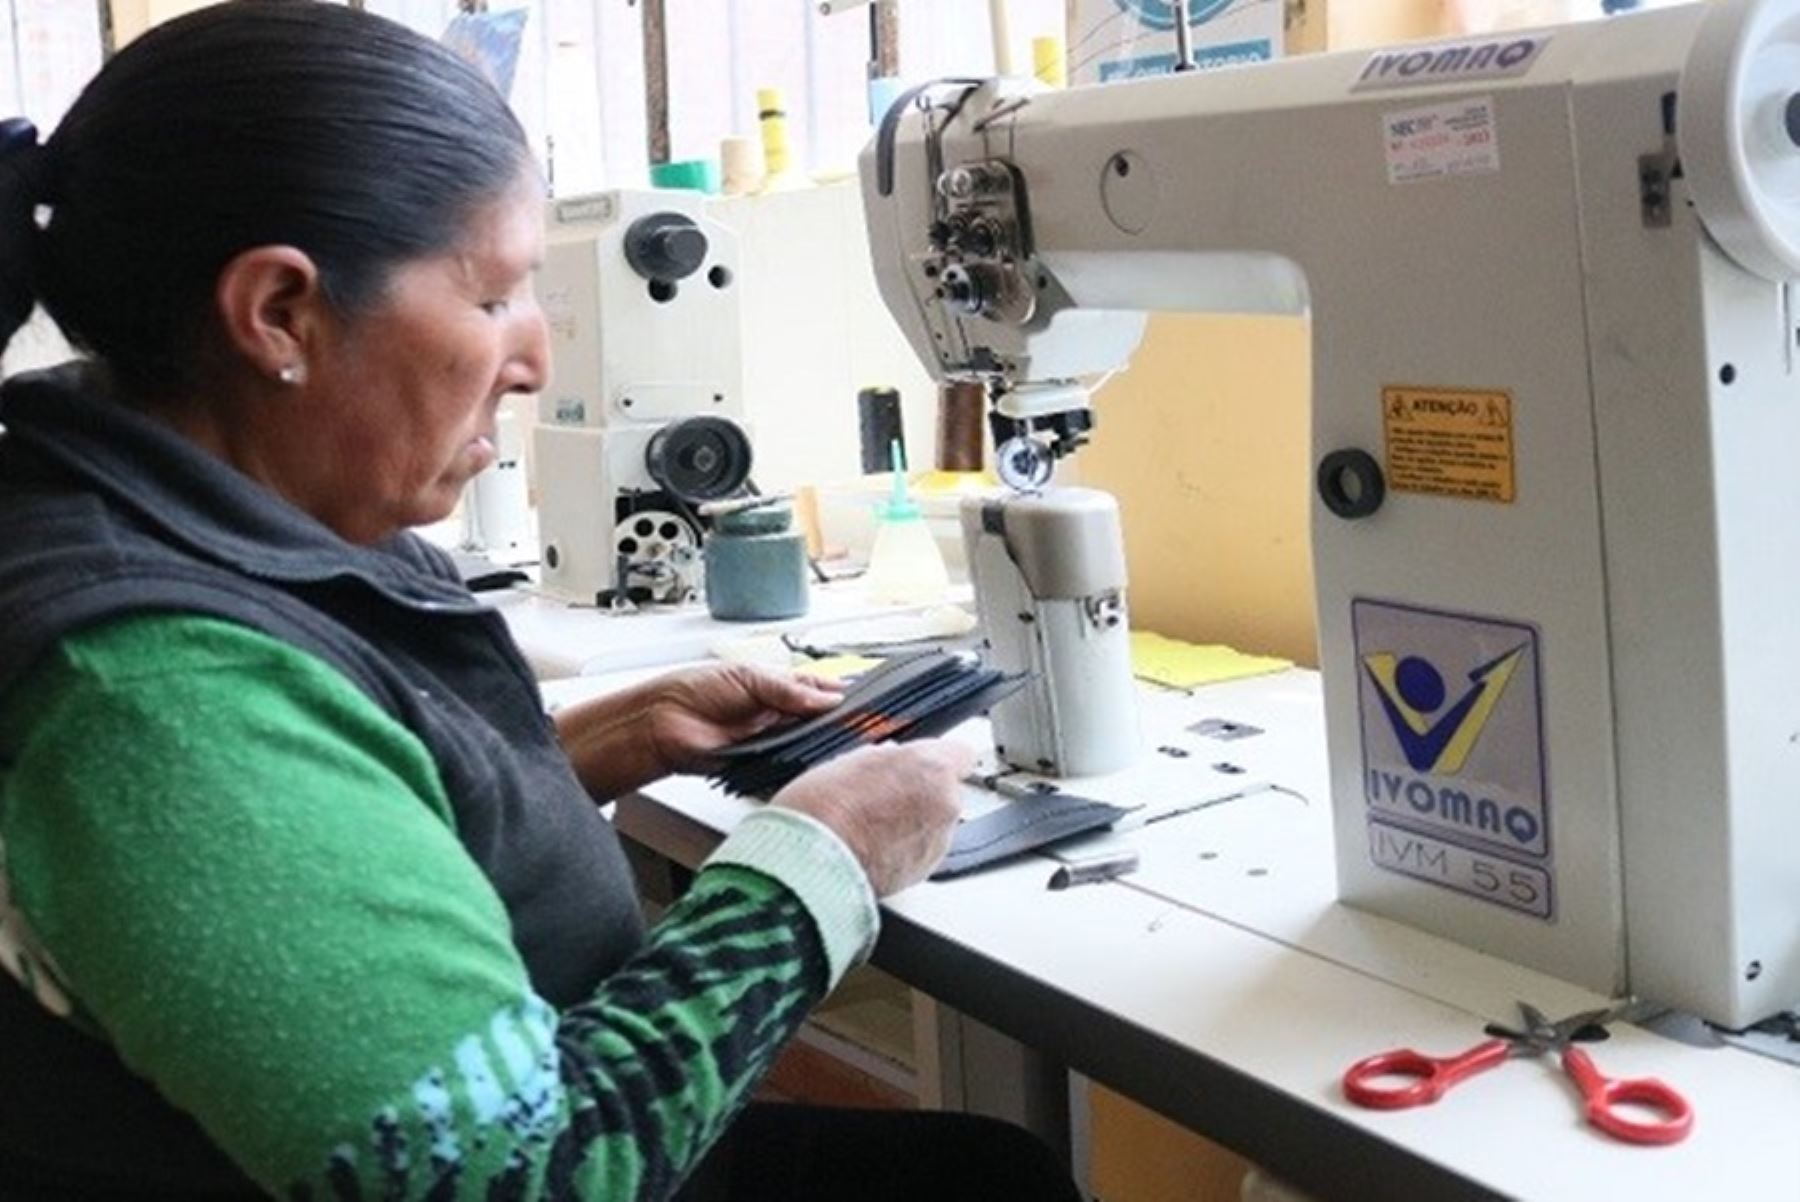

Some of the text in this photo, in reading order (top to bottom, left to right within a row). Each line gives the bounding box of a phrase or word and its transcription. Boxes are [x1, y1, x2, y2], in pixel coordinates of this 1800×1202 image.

[1361, 40, 1535, 80] IVOMAQ
[1371, 769, 1538, 844] IVOMAQ
[1378, 833, 1537, 903] IVM 55
